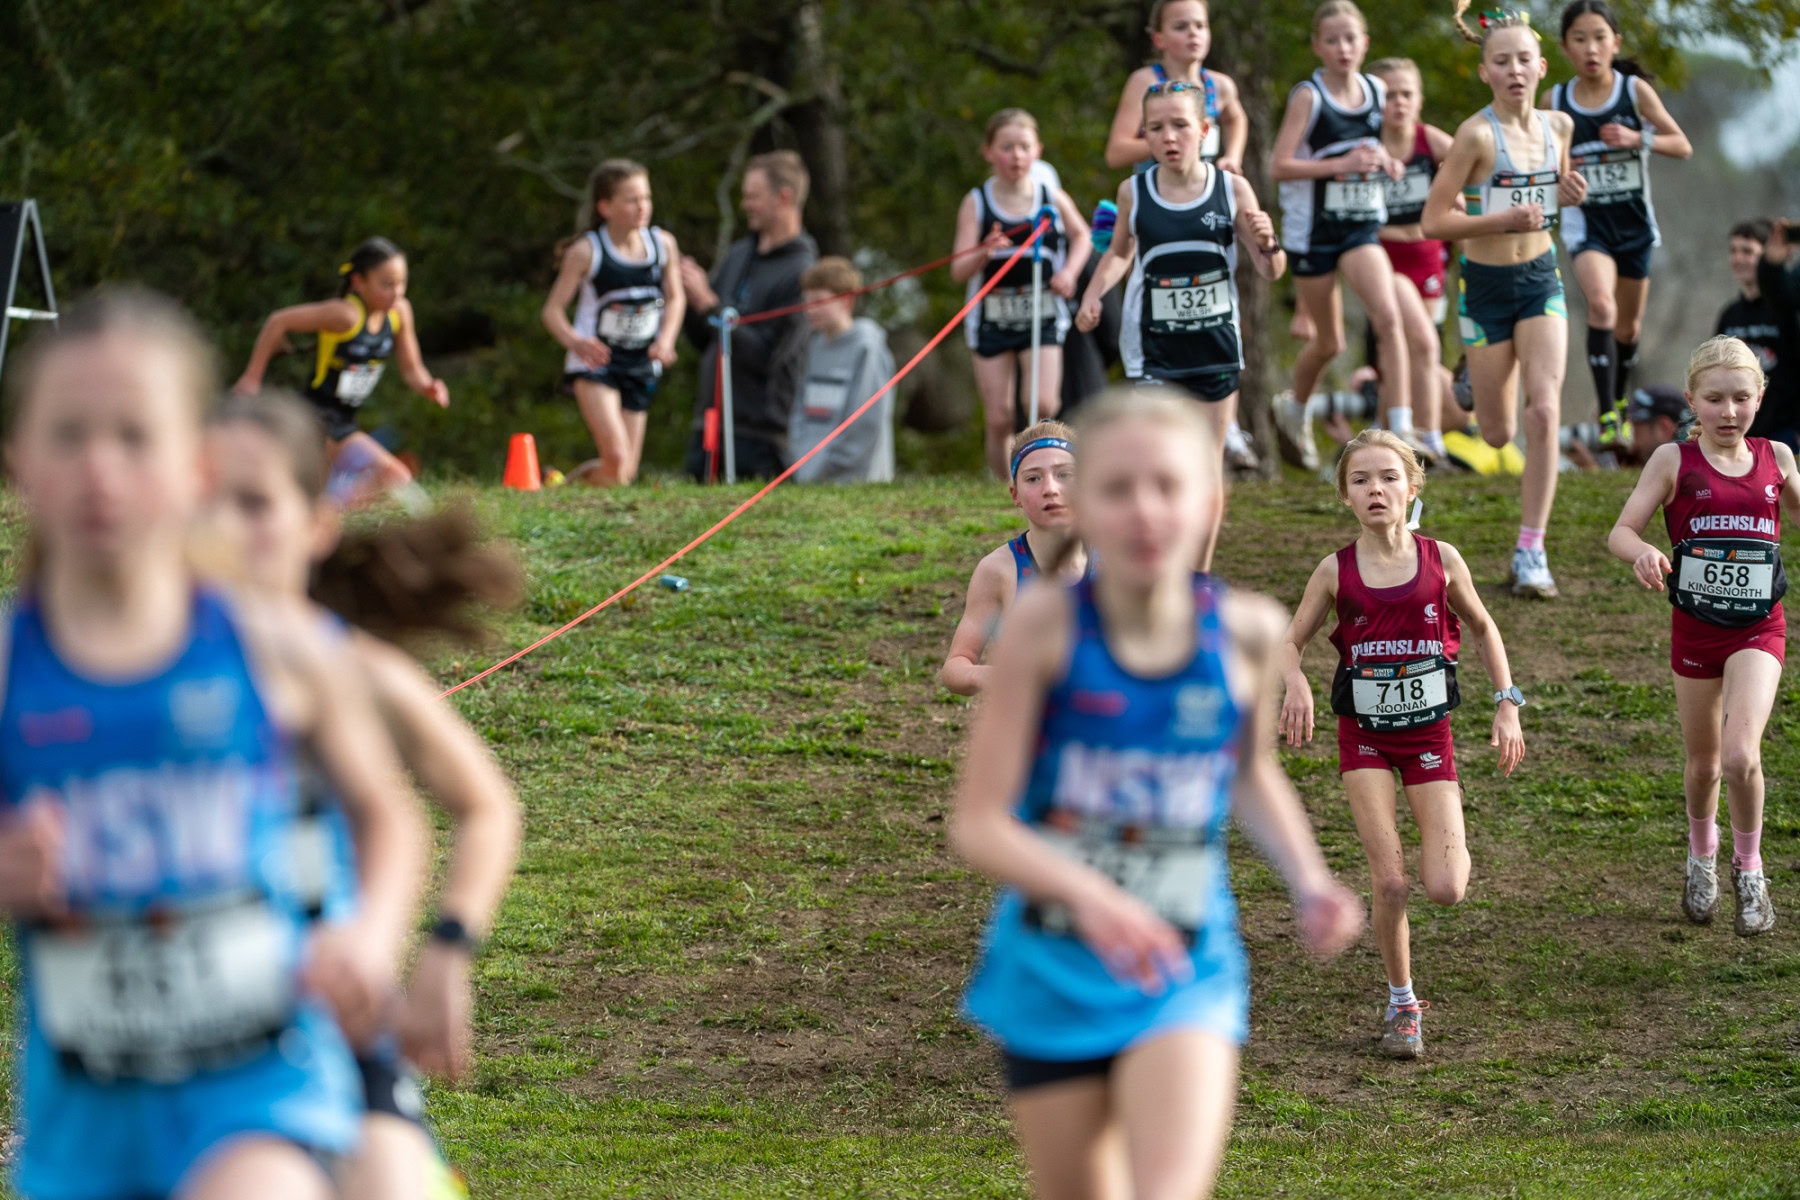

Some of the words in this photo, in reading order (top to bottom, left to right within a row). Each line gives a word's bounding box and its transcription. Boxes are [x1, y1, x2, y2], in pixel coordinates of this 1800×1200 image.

[1511, 188, 1545, 207] 918
[1168, 286, 1217, 310] 1321
[1177, 308, 1211, 318] WELSH
[1703, 563, 1750, 588] 658
[1687, 581, 1762, 598] KINGSNORTH
[1376, 678, 1424, 704] 718
[1376, 700, 1427, 714] NOONAN
